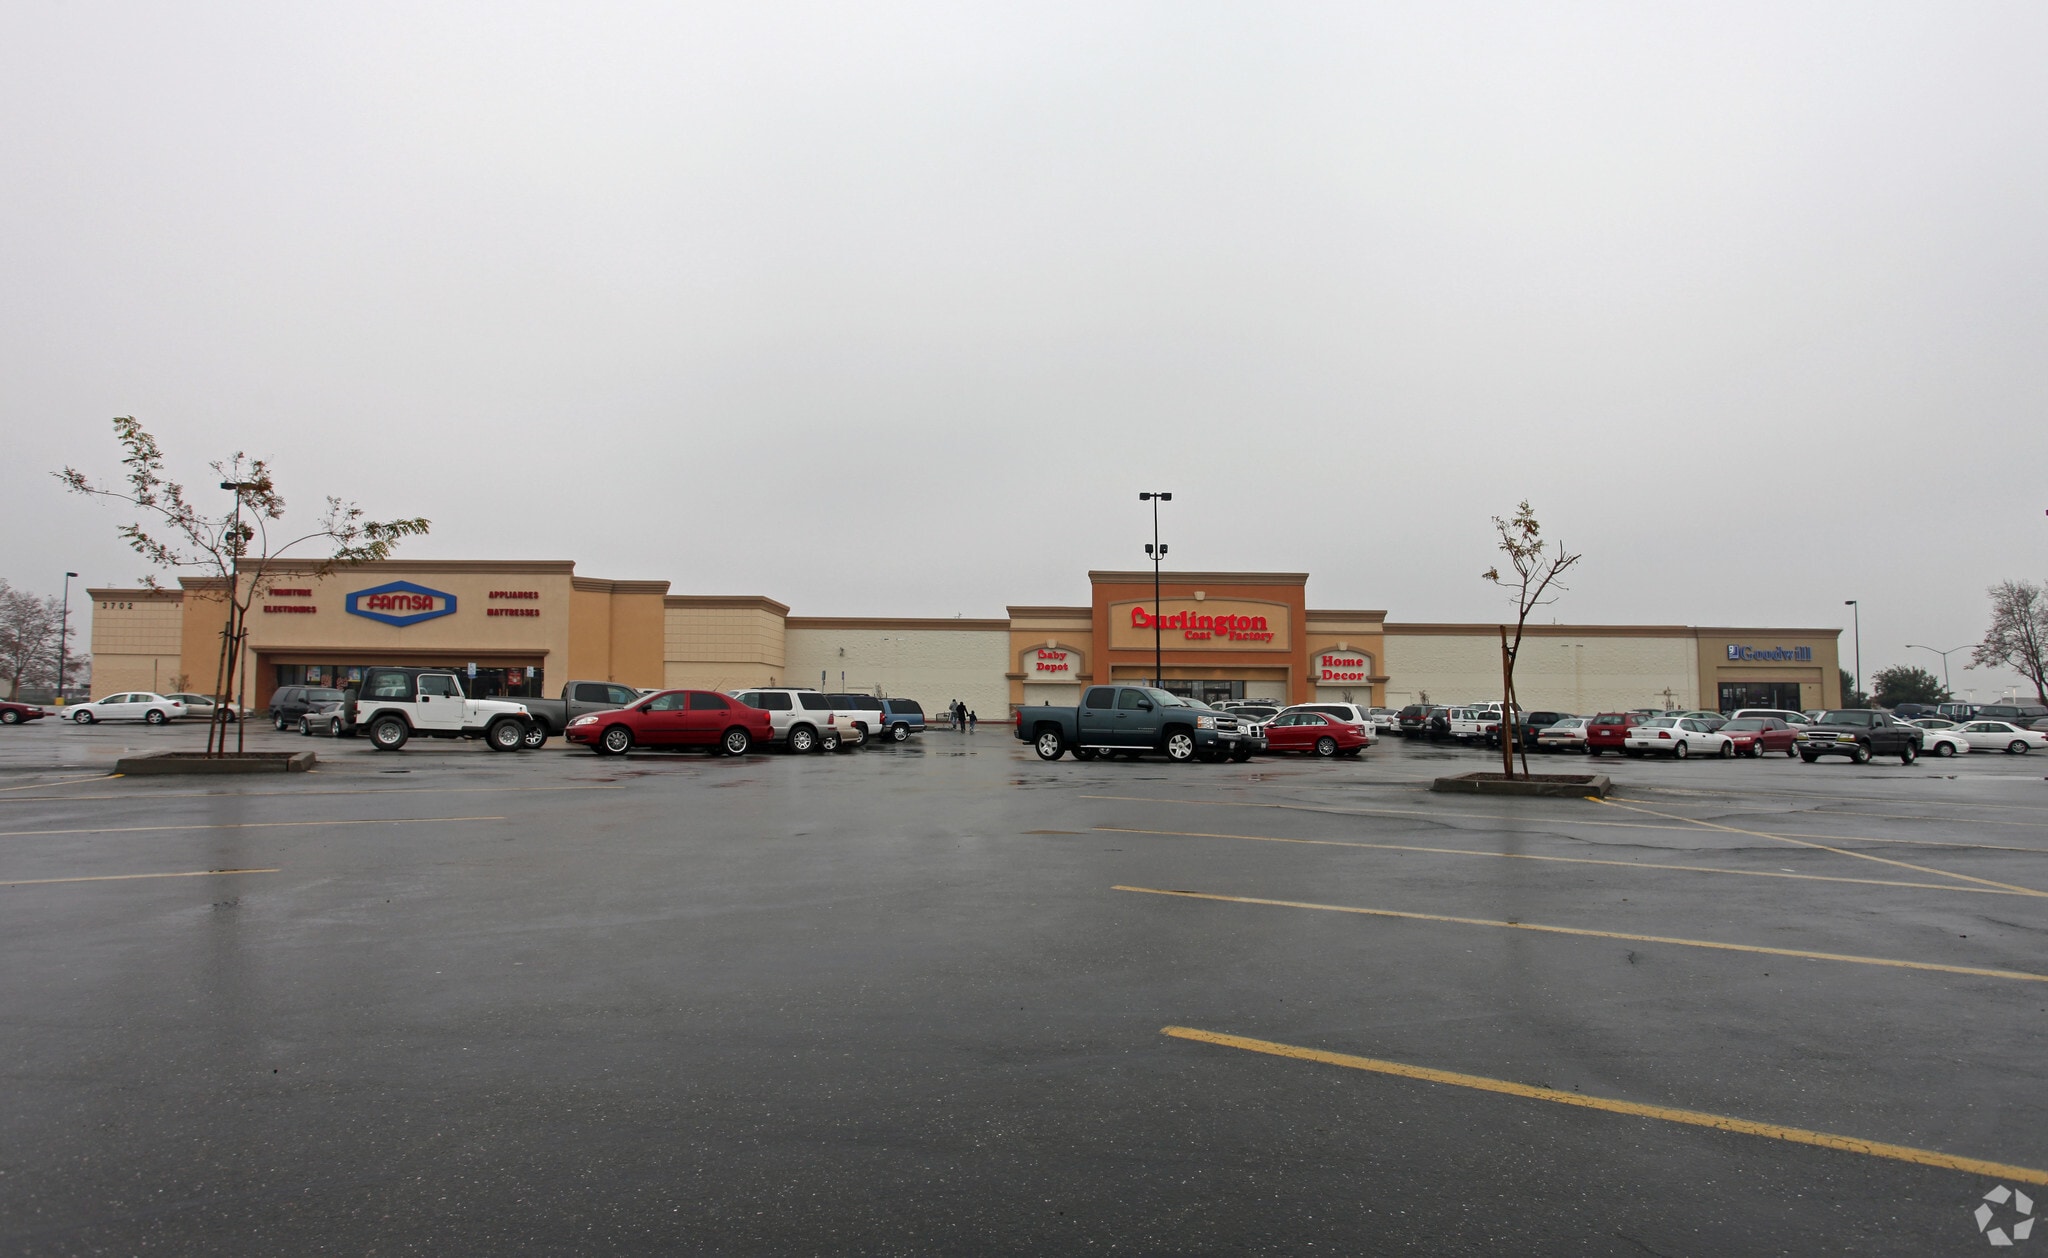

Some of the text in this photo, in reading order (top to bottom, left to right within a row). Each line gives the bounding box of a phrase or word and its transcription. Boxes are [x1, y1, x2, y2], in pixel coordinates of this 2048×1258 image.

[488, 590, 540, 600] APPLIANCES
[102, 602, 133, 610] 3702
[263, 605, 317, 614] ELECTRONICS
[486, 608, 541, 617] MATTRESSES
[1131, 606, 1268, 637] Burlington
[1184, 630, 1275, 643] Coat Factory
[1037, 649, 1068, 661] Baby
[1740, 645, 1812, 661] Goodwill
[1321, 655, 1364, 667] Home
[1036, 662, 1069, 673] Depot
[1321, 669, 1365, 681] Decor
